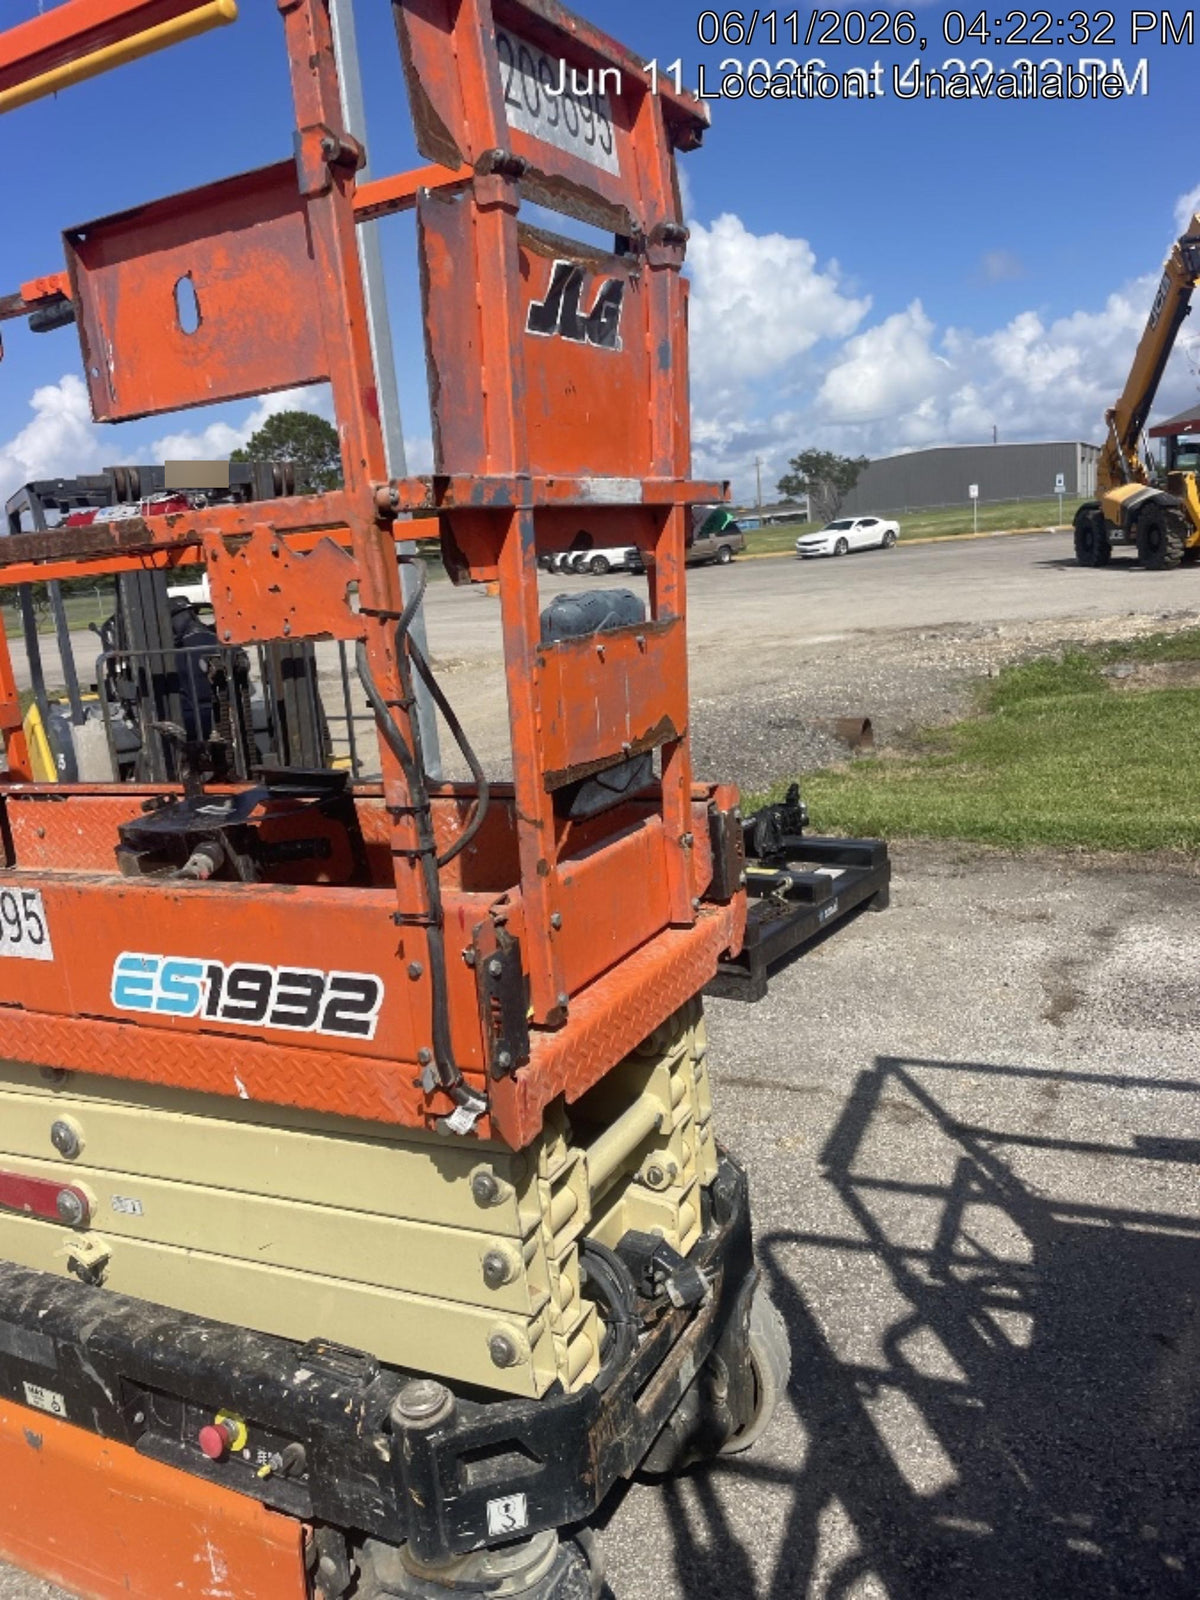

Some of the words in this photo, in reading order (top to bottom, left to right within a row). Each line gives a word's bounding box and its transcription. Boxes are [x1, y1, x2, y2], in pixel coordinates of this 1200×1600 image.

[525, 259, 624, 352] JLG
[0, 892, 45, 945] 95
[111, 952, 383, 1039] ES1932
